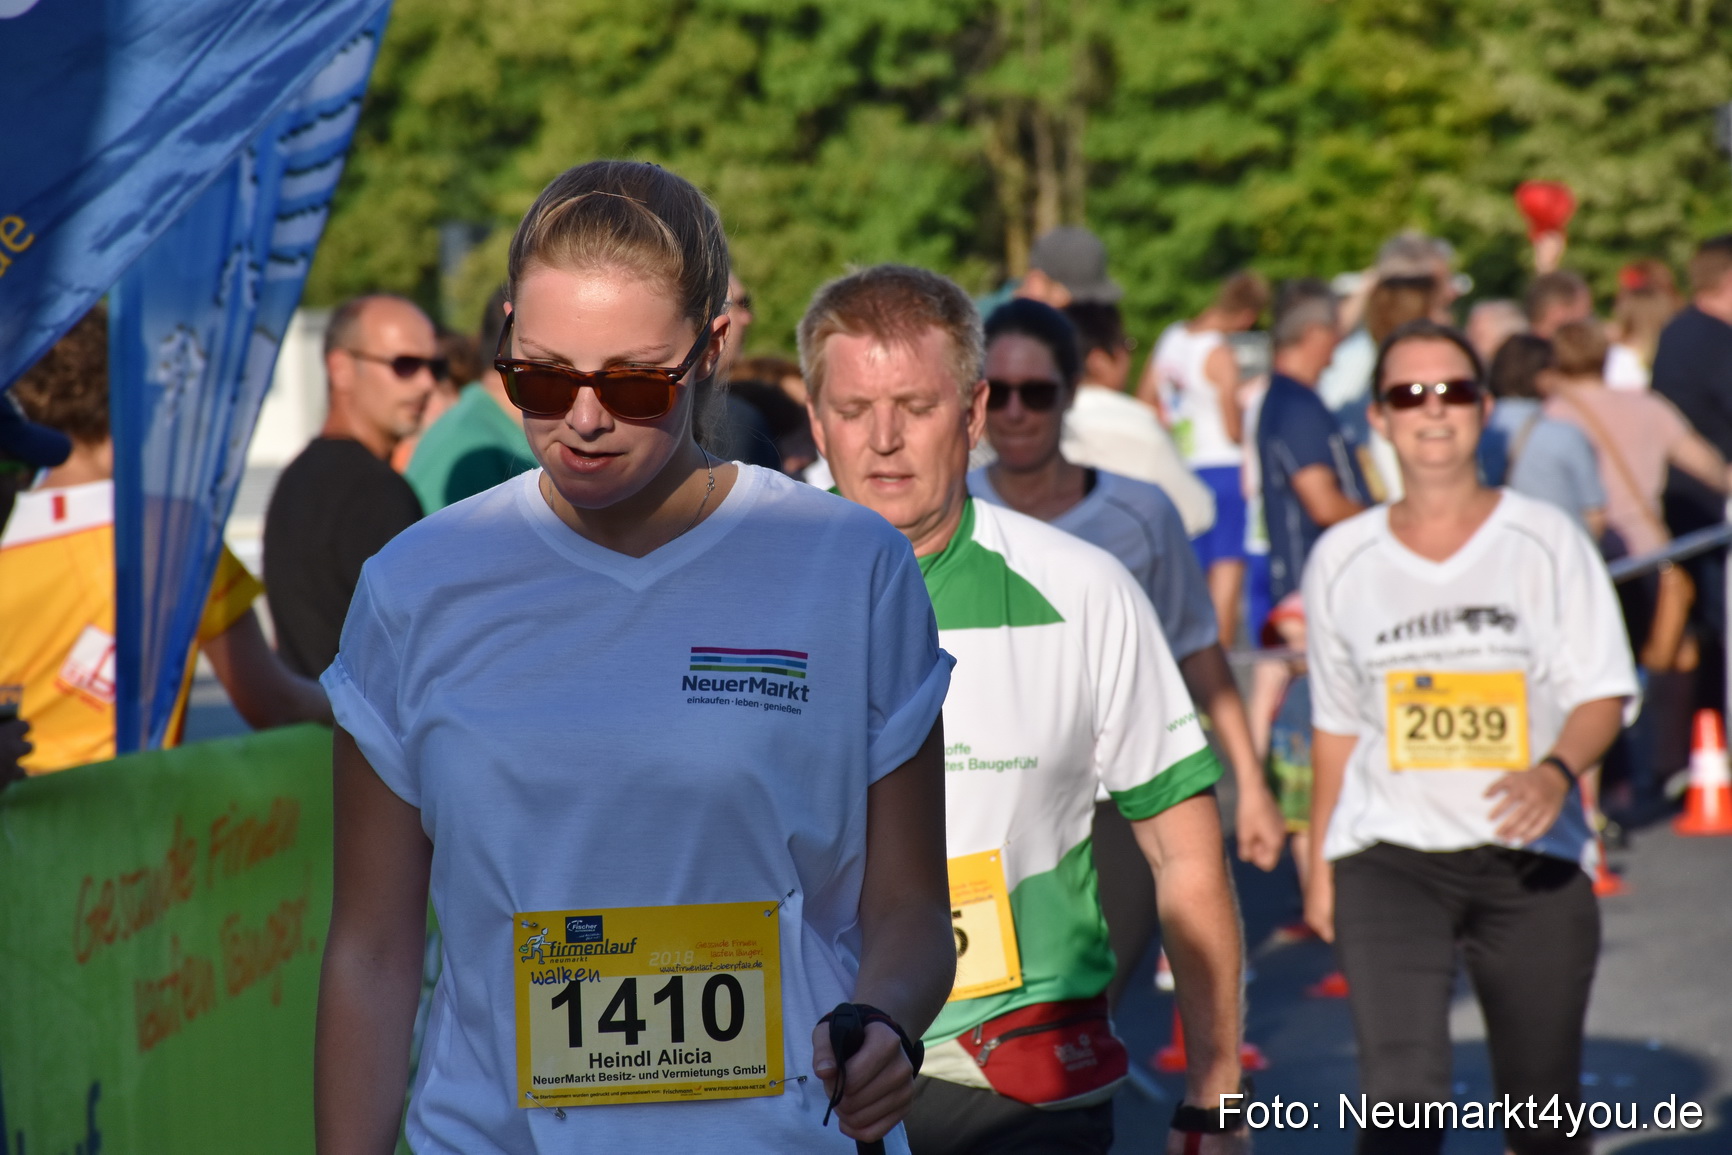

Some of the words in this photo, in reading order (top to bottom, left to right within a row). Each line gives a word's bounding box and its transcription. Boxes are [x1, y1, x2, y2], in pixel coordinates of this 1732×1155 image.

[682, 675, 810, 703] NeuerMarkt
[686, 696, 730, 706] einkaufen
[735, 697, 759, 708] leben
[763, 702, 802, 716] genießen
[1405, 704, 1507, 742] 2039
[968, 756, 1038, 773] Baugefühl
[550, 937, 638, 957] firmenlauf
[550, 956, 588, 964] neumarkt
[649, 950, 695, 967] 2018
[530, 966, 601, 985] walken
[551, 973, 745, 1049] 1410
[589, 1050, 651, 1069] Heindl
[657, 1048, 712, 1066] Alicia
[533, 1073, 596, 1085] NeuerMarkt
[598, 1071, 636, 1082] Besitz-
[639, 1069, 659, 1080] und
[661, 1067, 730, 1079] Vermietungs
[732, 1064, 766, 1075] GmbH
